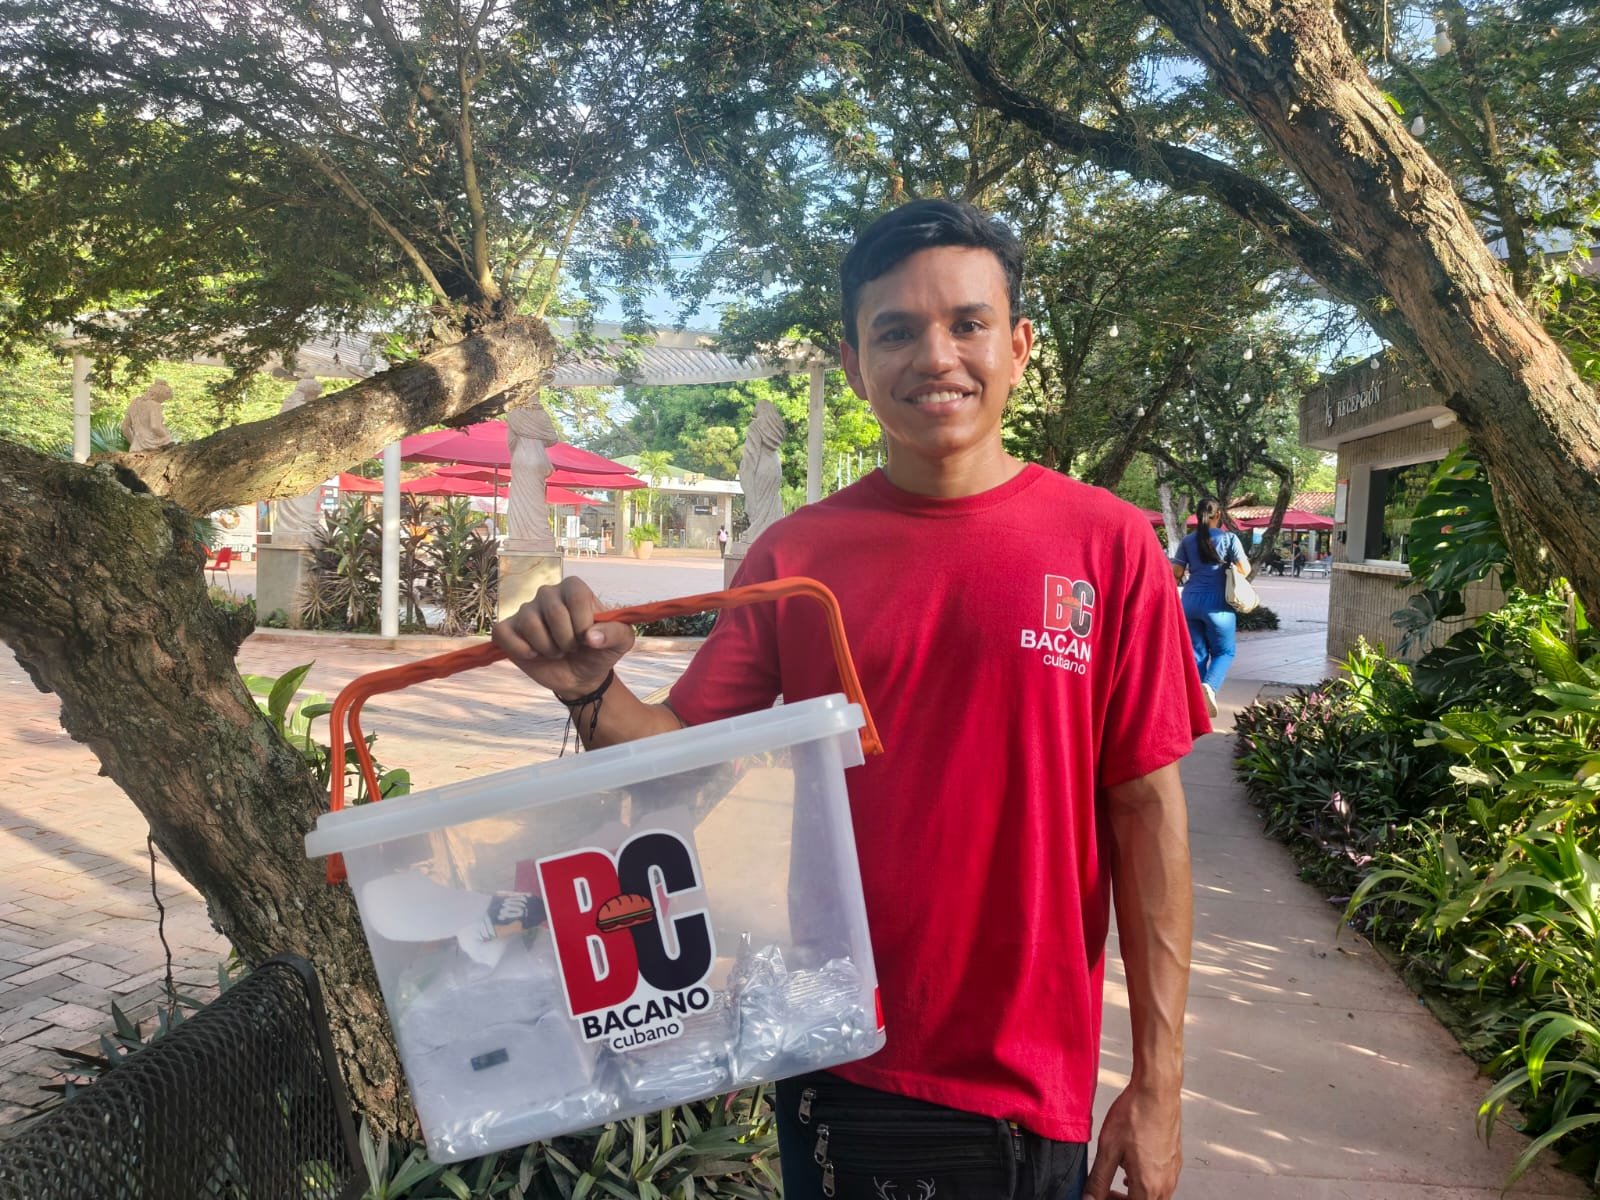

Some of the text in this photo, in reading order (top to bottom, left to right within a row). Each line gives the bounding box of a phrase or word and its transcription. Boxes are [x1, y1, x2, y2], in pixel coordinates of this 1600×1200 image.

[1337, 380, 1380, 417] RECEPCIÓN
[1043, 574, 1096, 638] BC
[1020, 629, 1092, 663] BACAN
[536, 829, 716, 1018] BC
[582, 986, 711, 1039] BACANO
[612, 1022, 680, 1050] cubano
